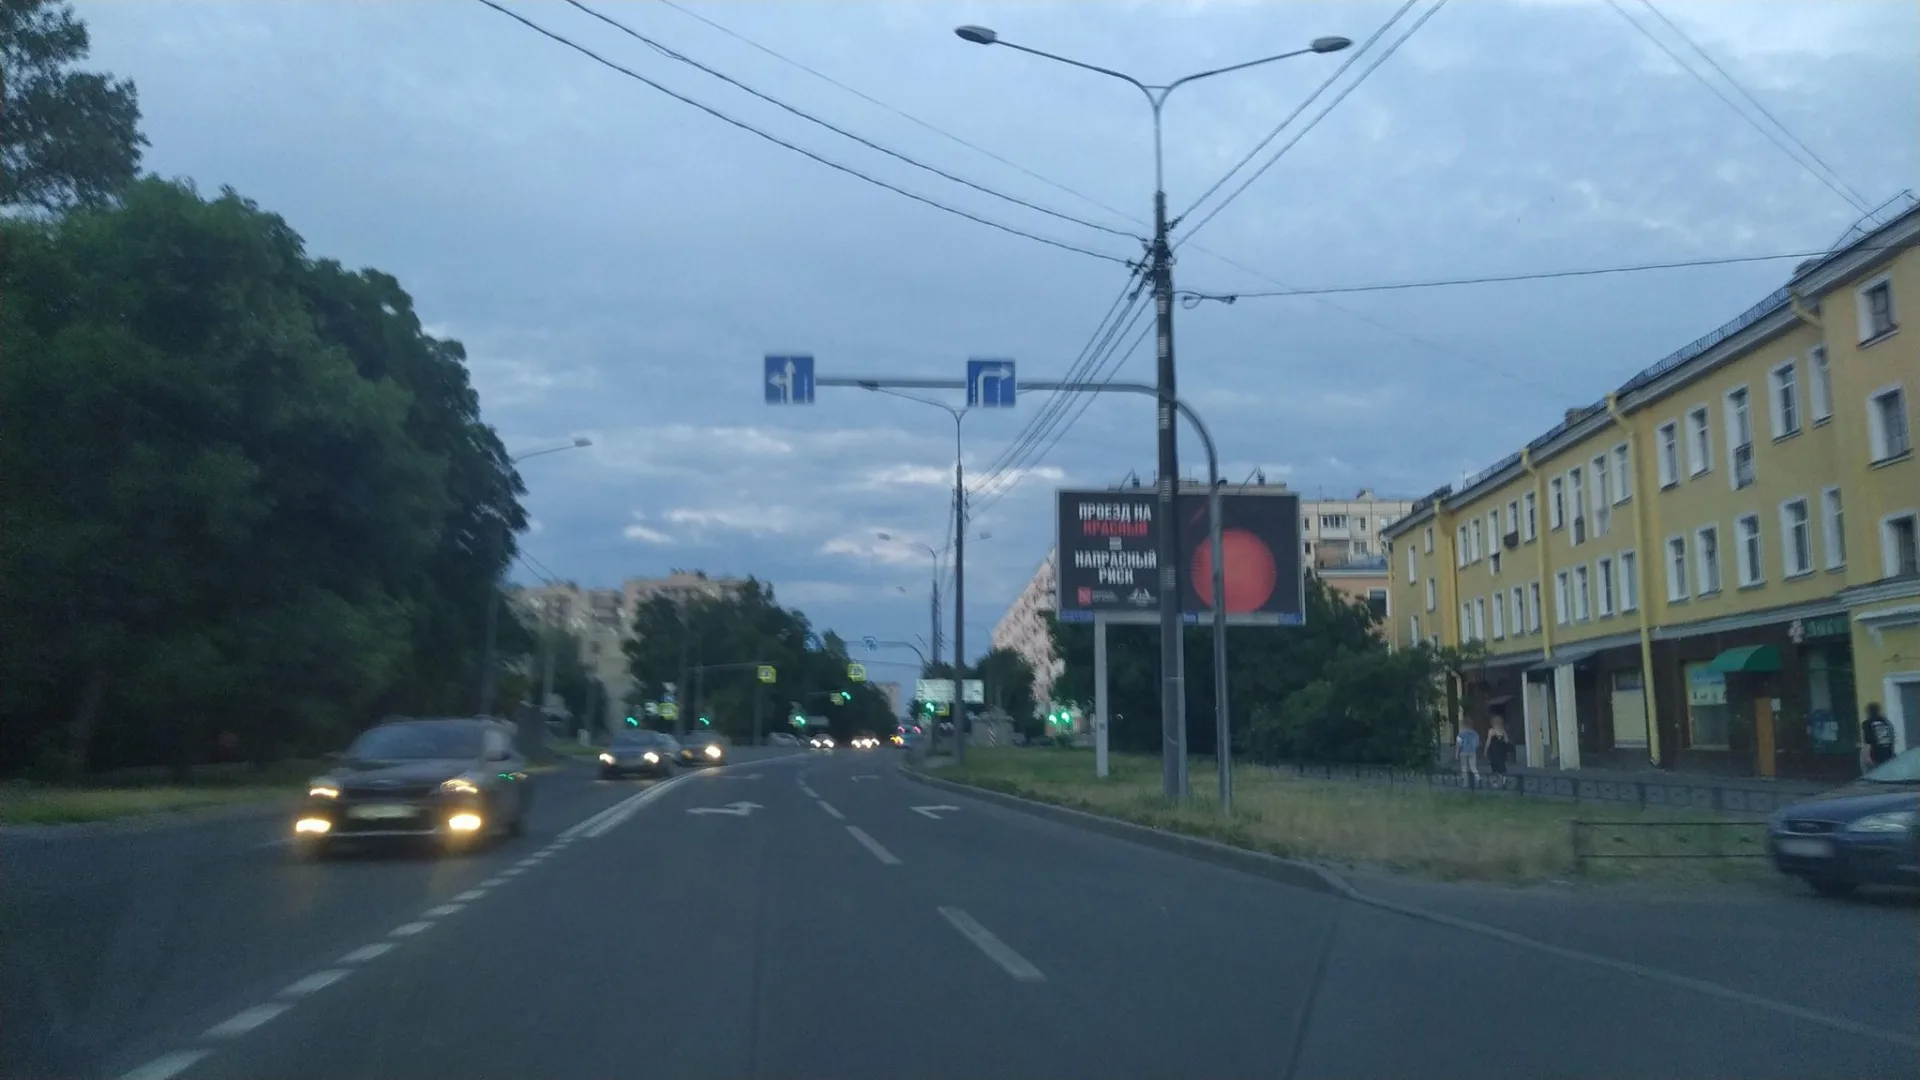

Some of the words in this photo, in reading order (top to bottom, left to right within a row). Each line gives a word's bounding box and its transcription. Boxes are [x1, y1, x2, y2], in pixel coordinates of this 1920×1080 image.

[1079, 502, 1131, 522] ПРОЕЗД
[1134, 503, 1151, 521] НА
[1075, 549, 1156, 568] НАПРАСНЫЙ
[1098, 568, 1133, 584] РИСК
